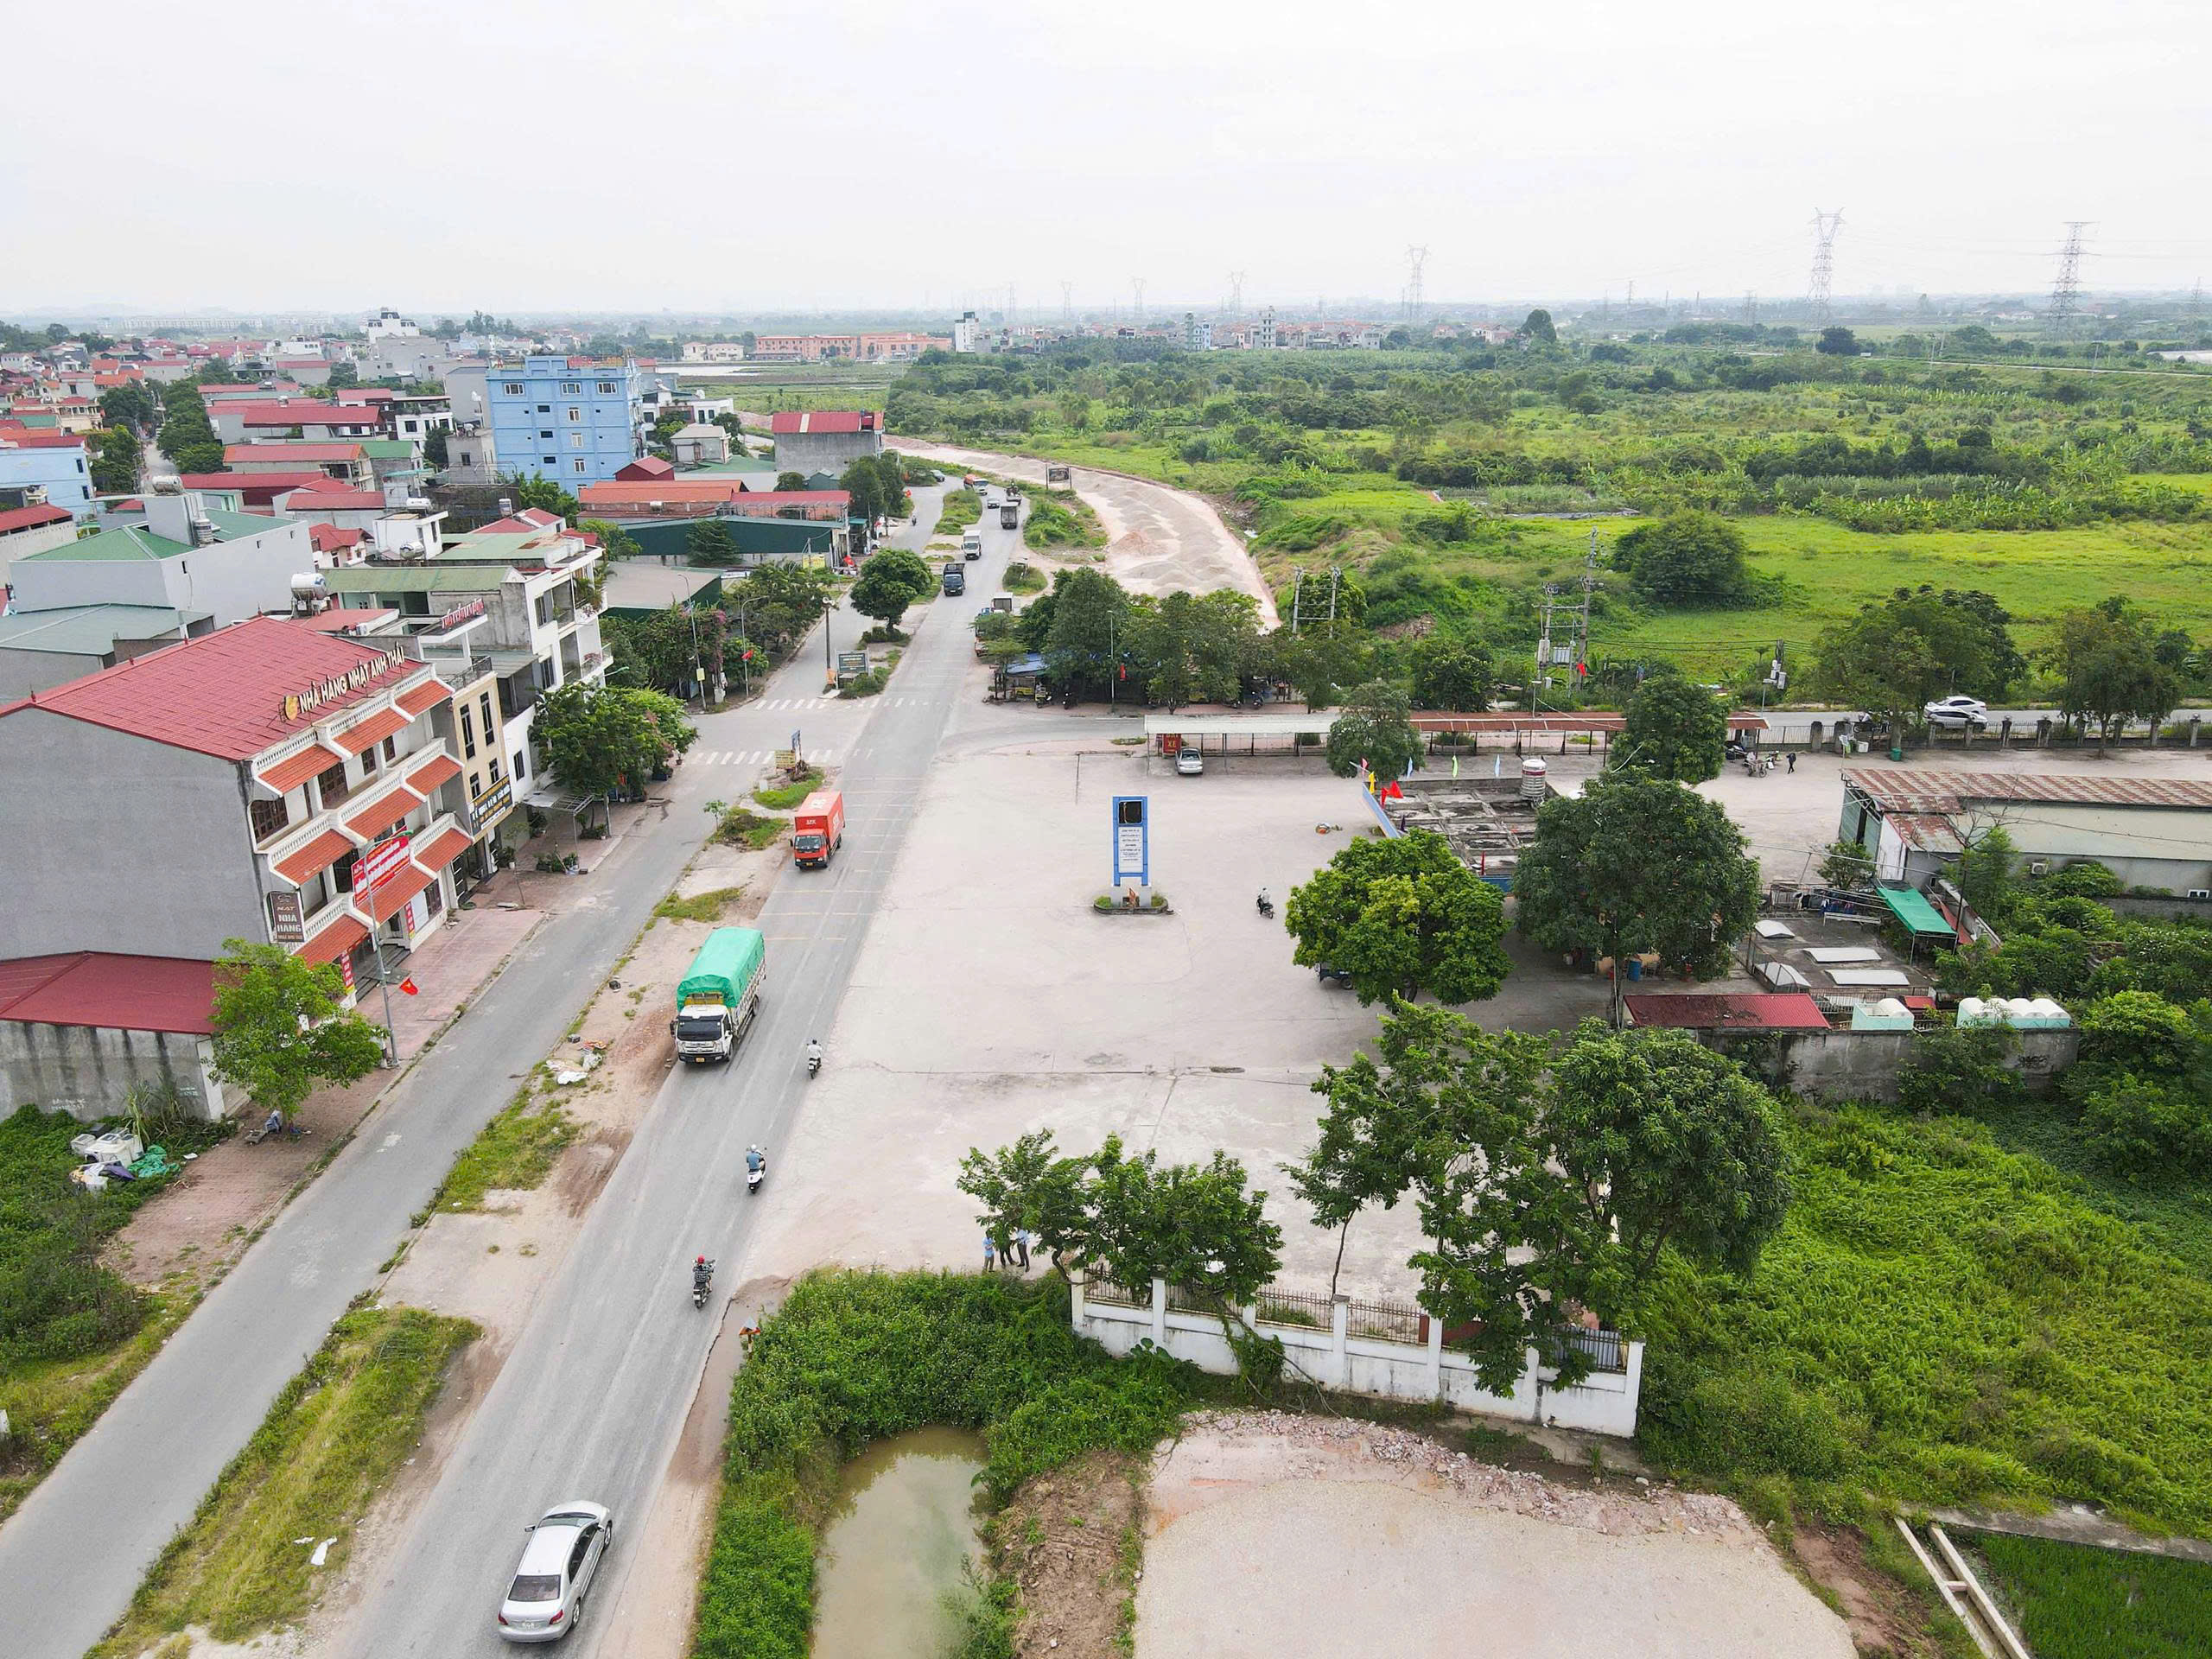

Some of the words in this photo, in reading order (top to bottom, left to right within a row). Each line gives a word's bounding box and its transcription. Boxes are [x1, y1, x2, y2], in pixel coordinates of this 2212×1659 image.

[298, 681, 321, 714] NHÀ
[320, 674, 347, 703] HÀNG
[347, 659, 370, 689] NHẬT
[370, 657, 388, 679] ANH
[386, 641, 405, 670] THÁI
